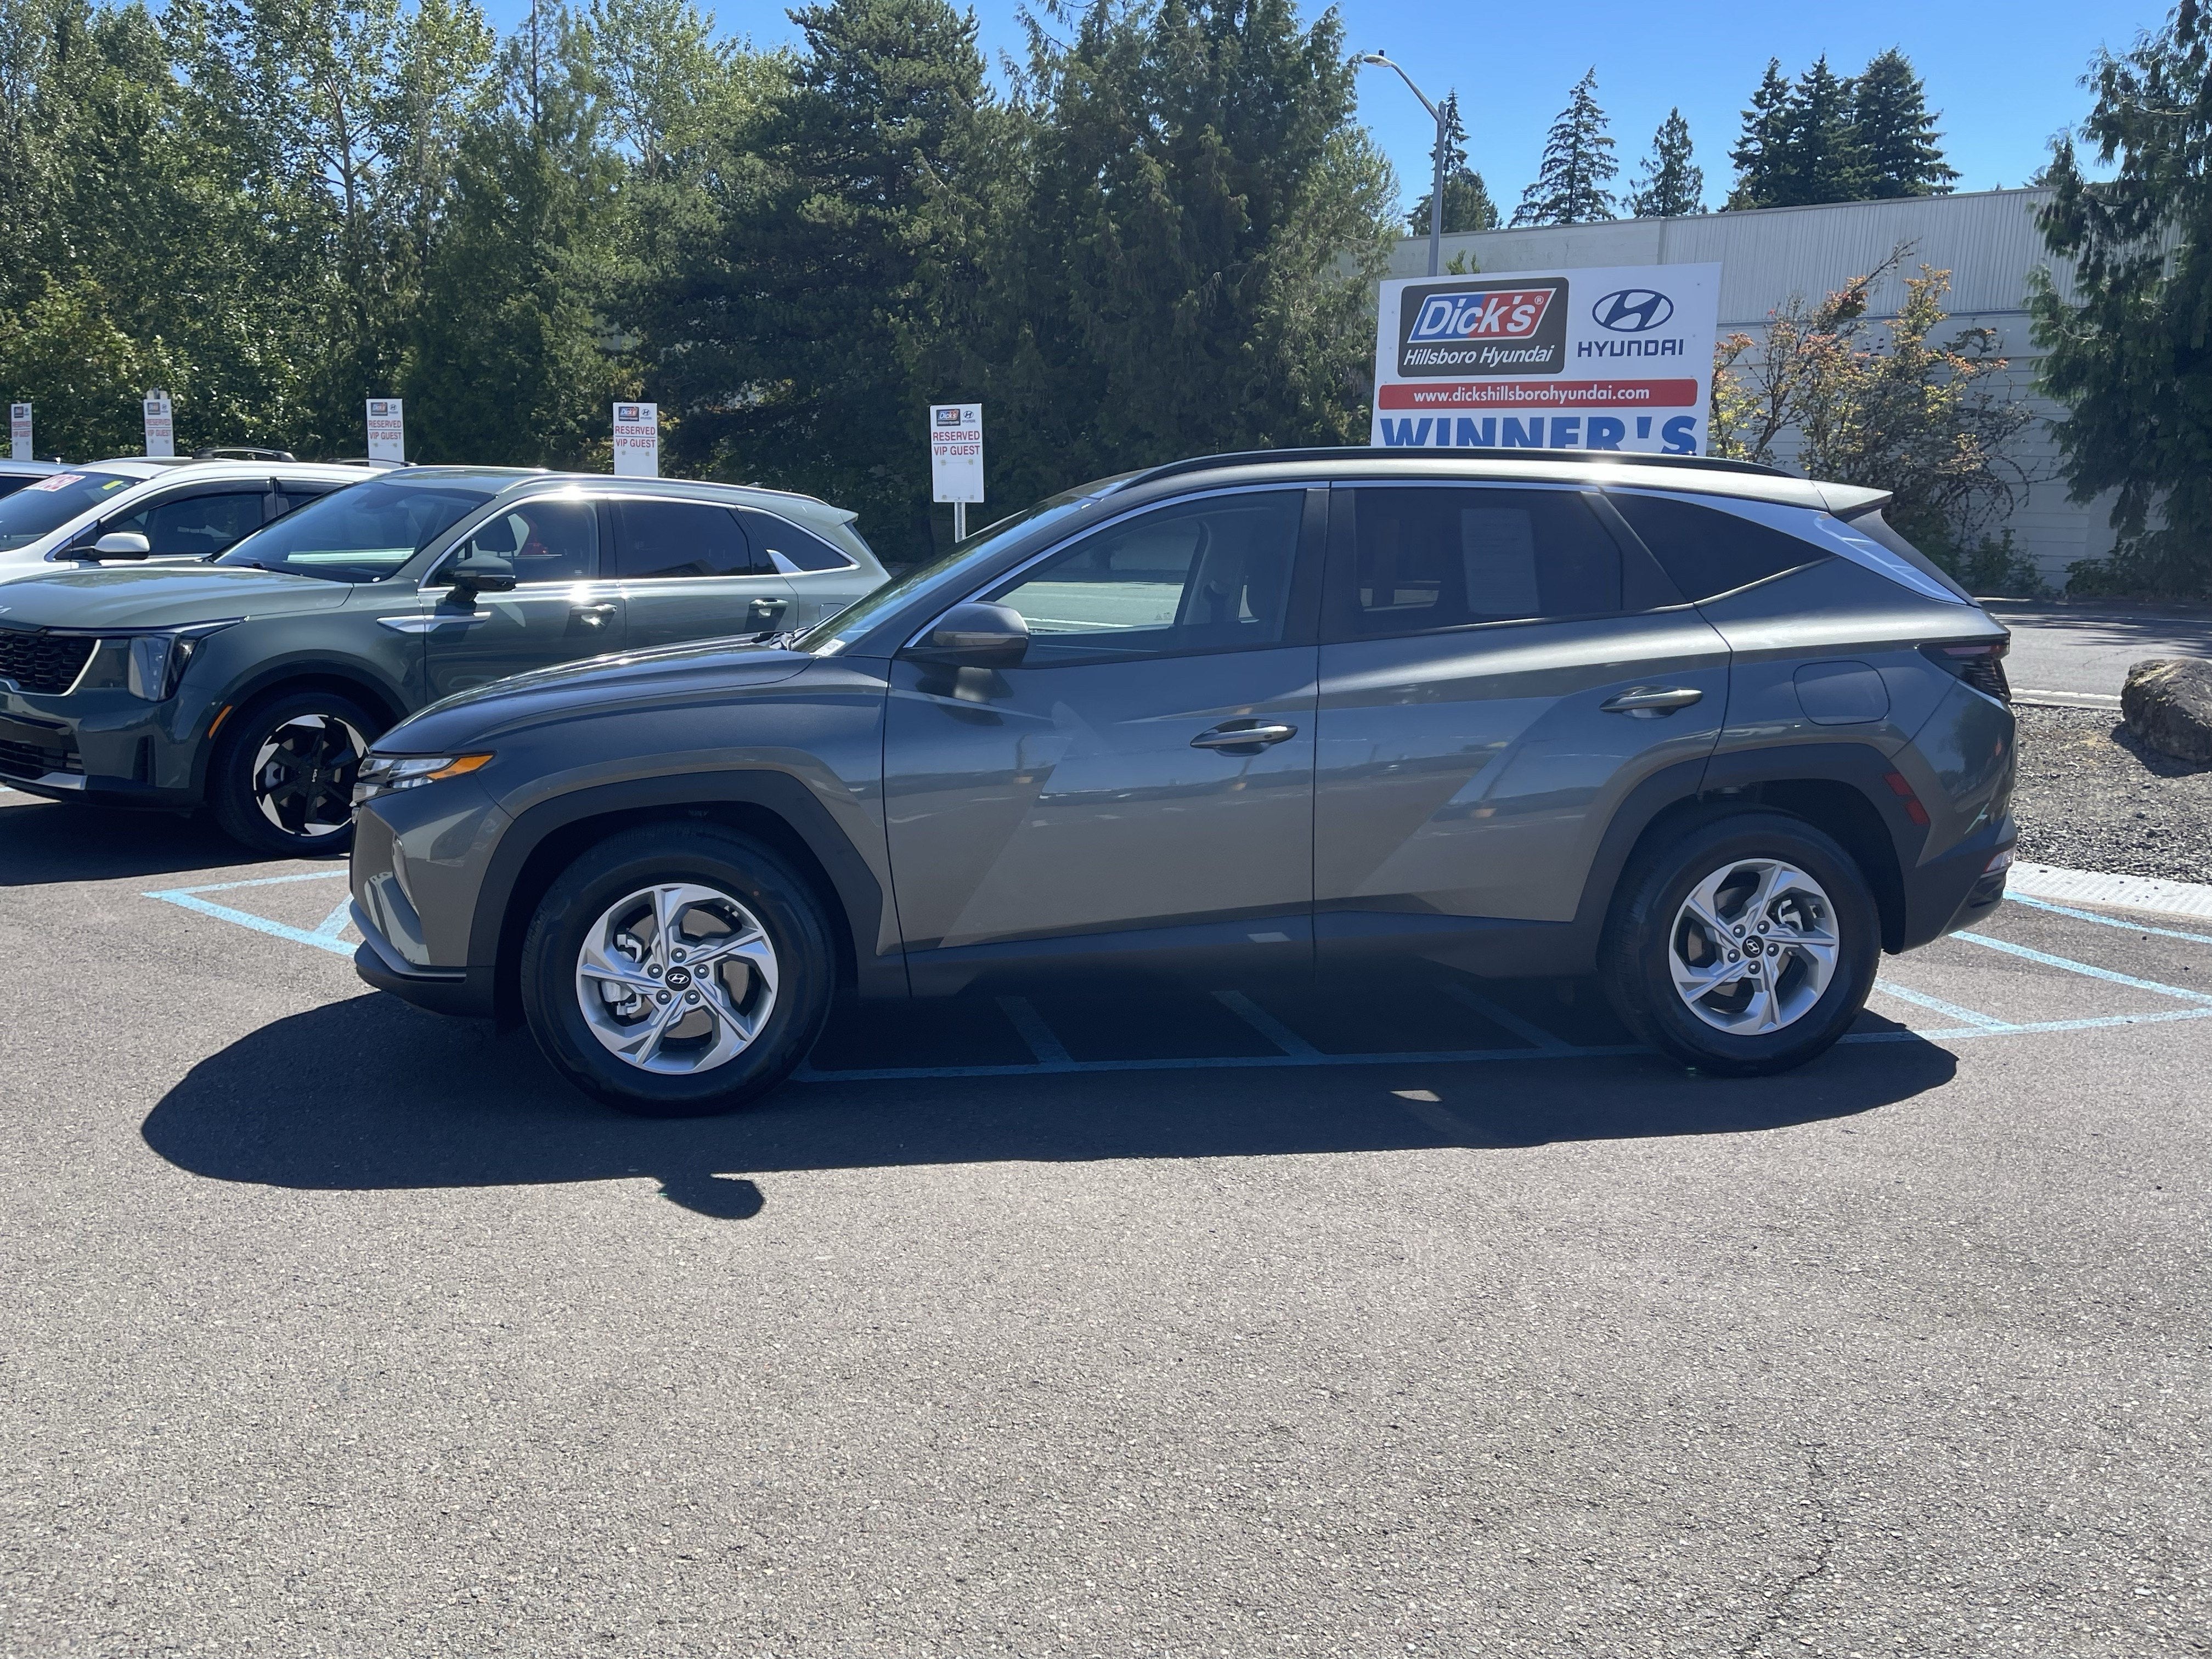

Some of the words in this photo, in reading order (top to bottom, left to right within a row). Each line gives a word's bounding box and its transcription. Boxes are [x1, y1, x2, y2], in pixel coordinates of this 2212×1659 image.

[1578, 338, 1684, 358] HYUNDAI
[1403, 348, 1477, 366] Hillsboro
[1479, 345, 1555, 368] Hyundai
[1414, 385, 1650, 405] www.dickshillsborohyundai.com
[615, 426, 656, 435] RESERVED
[933, 431, 980, 442] RESERVED
[1380, 415, 1697, 455] WINNER'S
[616, 438, 628, 447] VIP
[630, 439, 656, 448] GUEST
[934, 446, 947, 456] VIP
[950, 445, 980, 456] GUEST
